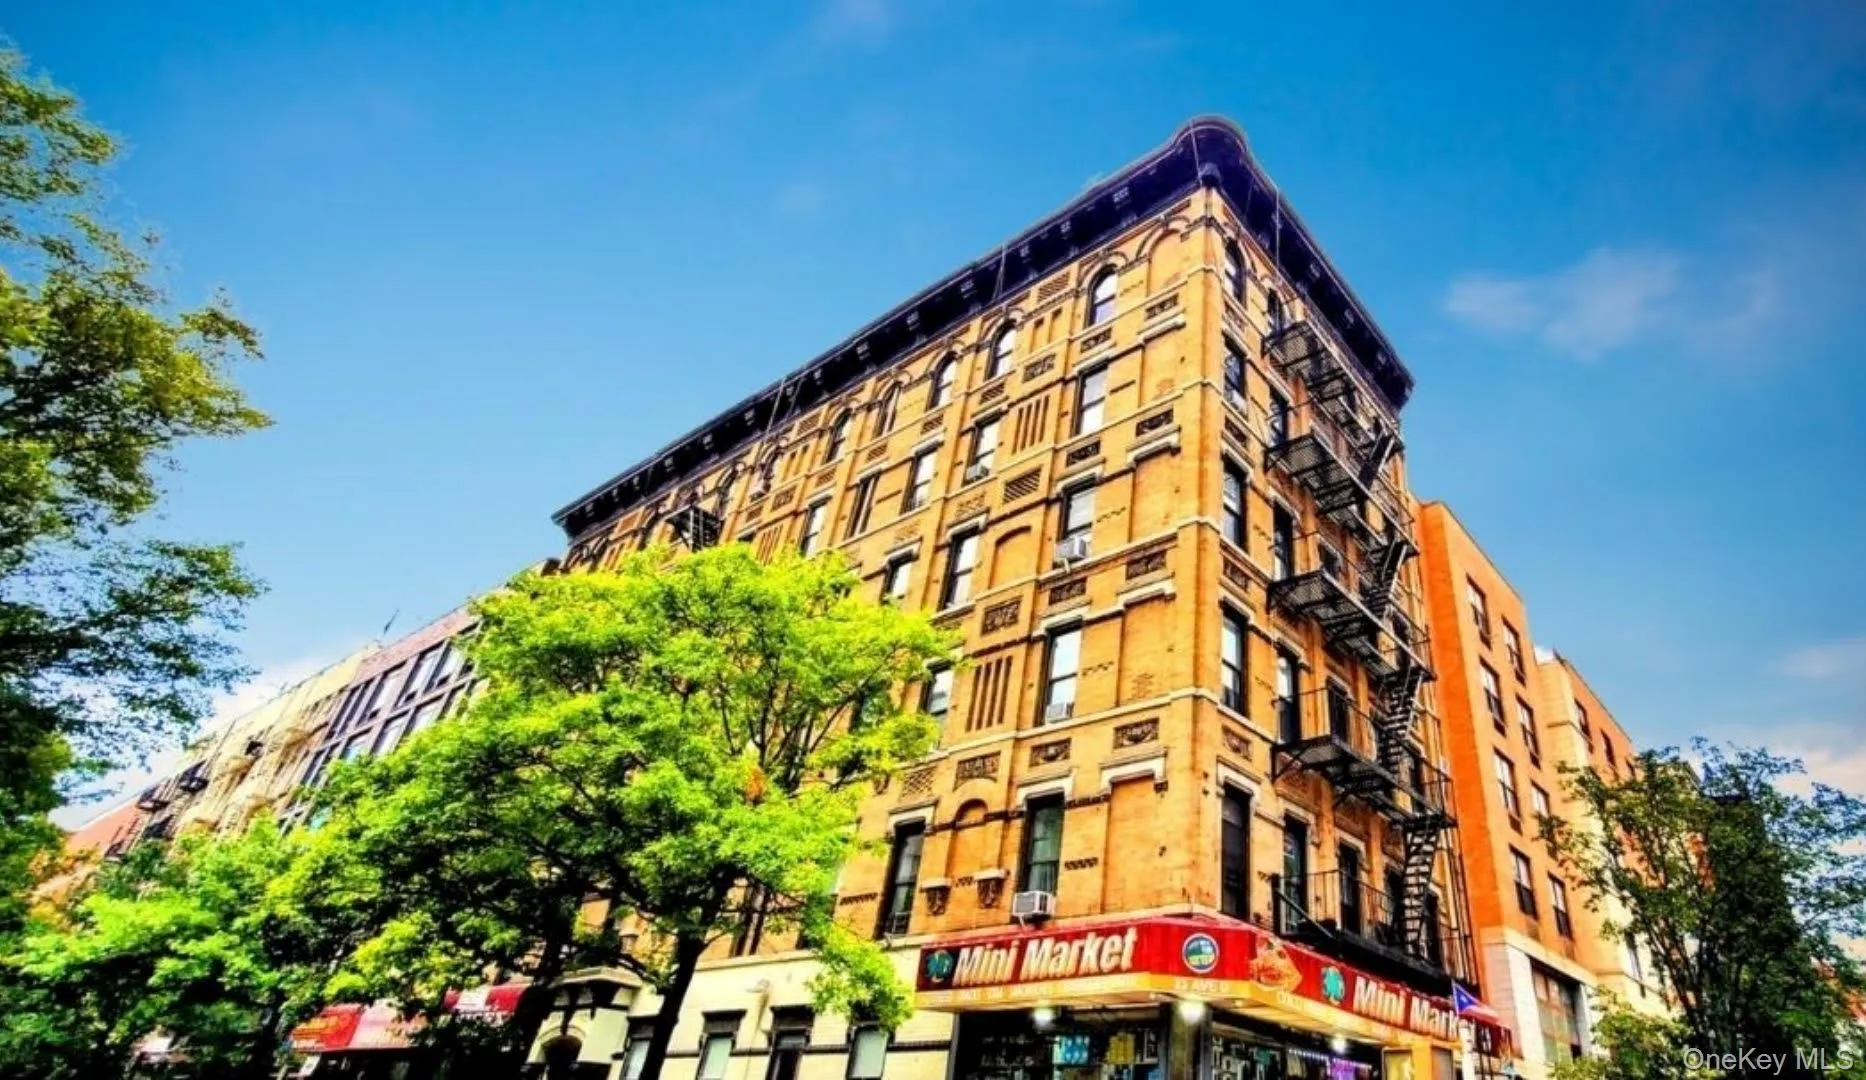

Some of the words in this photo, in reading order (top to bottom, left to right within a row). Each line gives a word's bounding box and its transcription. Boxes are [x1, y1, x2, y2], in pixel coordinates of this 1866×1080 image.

[952, 939, 1020, 987] Mini
[1019, 927, 1137, 981] Market
[1353, 975, 1406, 1026] Mini
